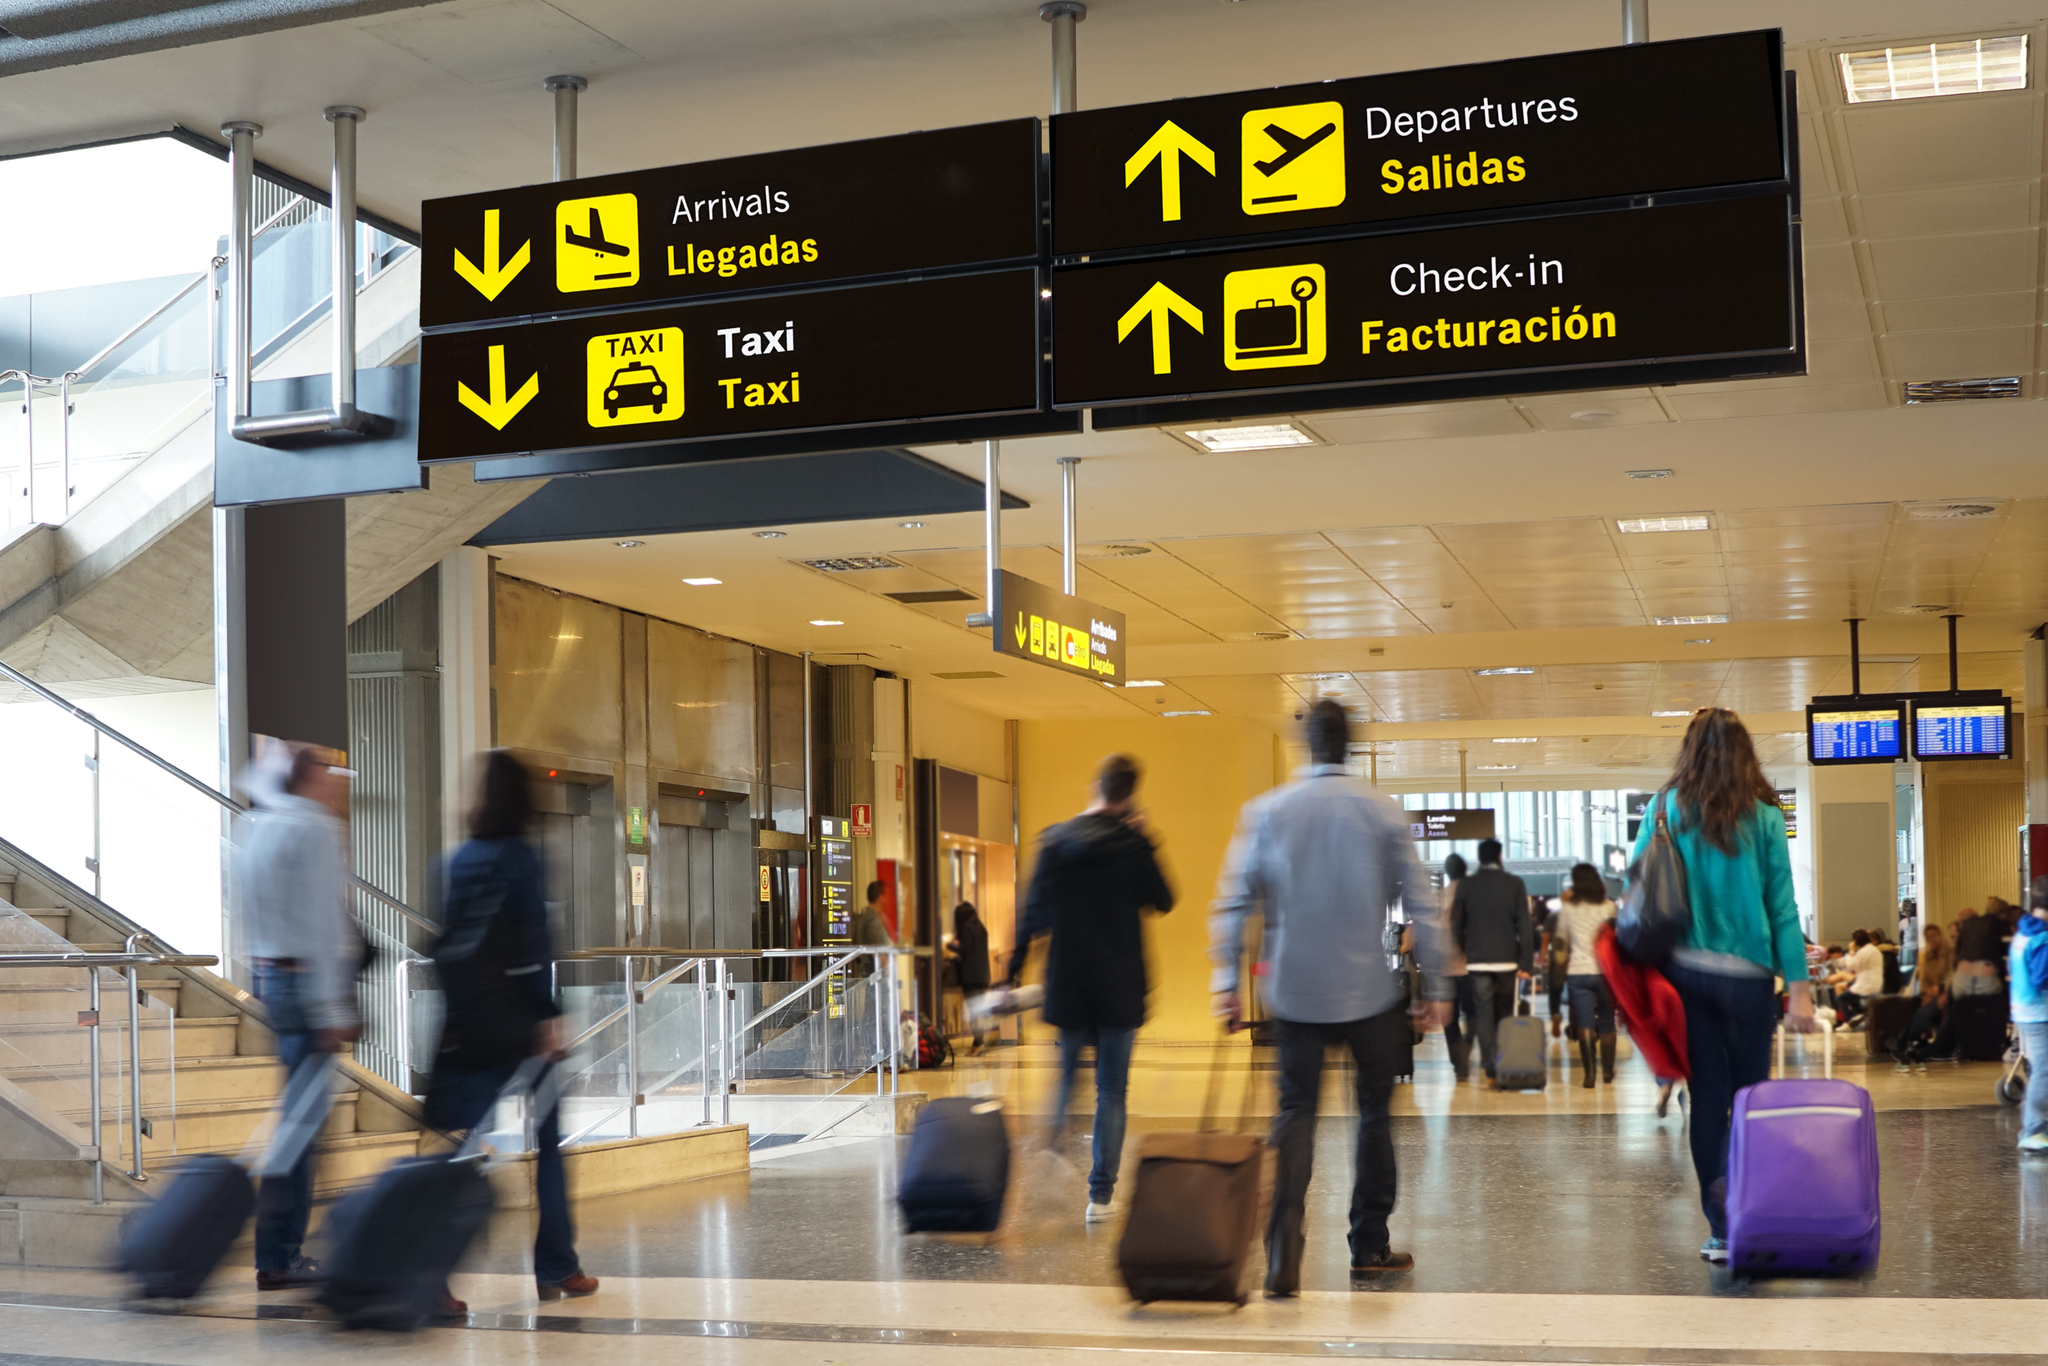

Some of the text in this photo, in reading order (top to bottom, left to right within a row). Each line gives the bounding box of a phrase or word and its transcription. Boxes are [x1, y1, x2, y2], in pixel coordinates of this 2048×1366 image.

[1366, 96, 1579, 143] Departures
[1380, 151, 1526, 195] Salidas
[672, 185, 790, 225] Arrivals
[667, 234, 819, 278] Llegadas
[1390, 253, 1563, 296] Check-in
[605, 333, 664, 358] TAXI
[717, 320, 795, 359] Taxi
[1361, 303, 1616, 355] Facturación
[717, 371, 800, 409] Taxi
[1068, 641, 1086, 659] metro
[1091, 654, 1115, 676] Llegadas
